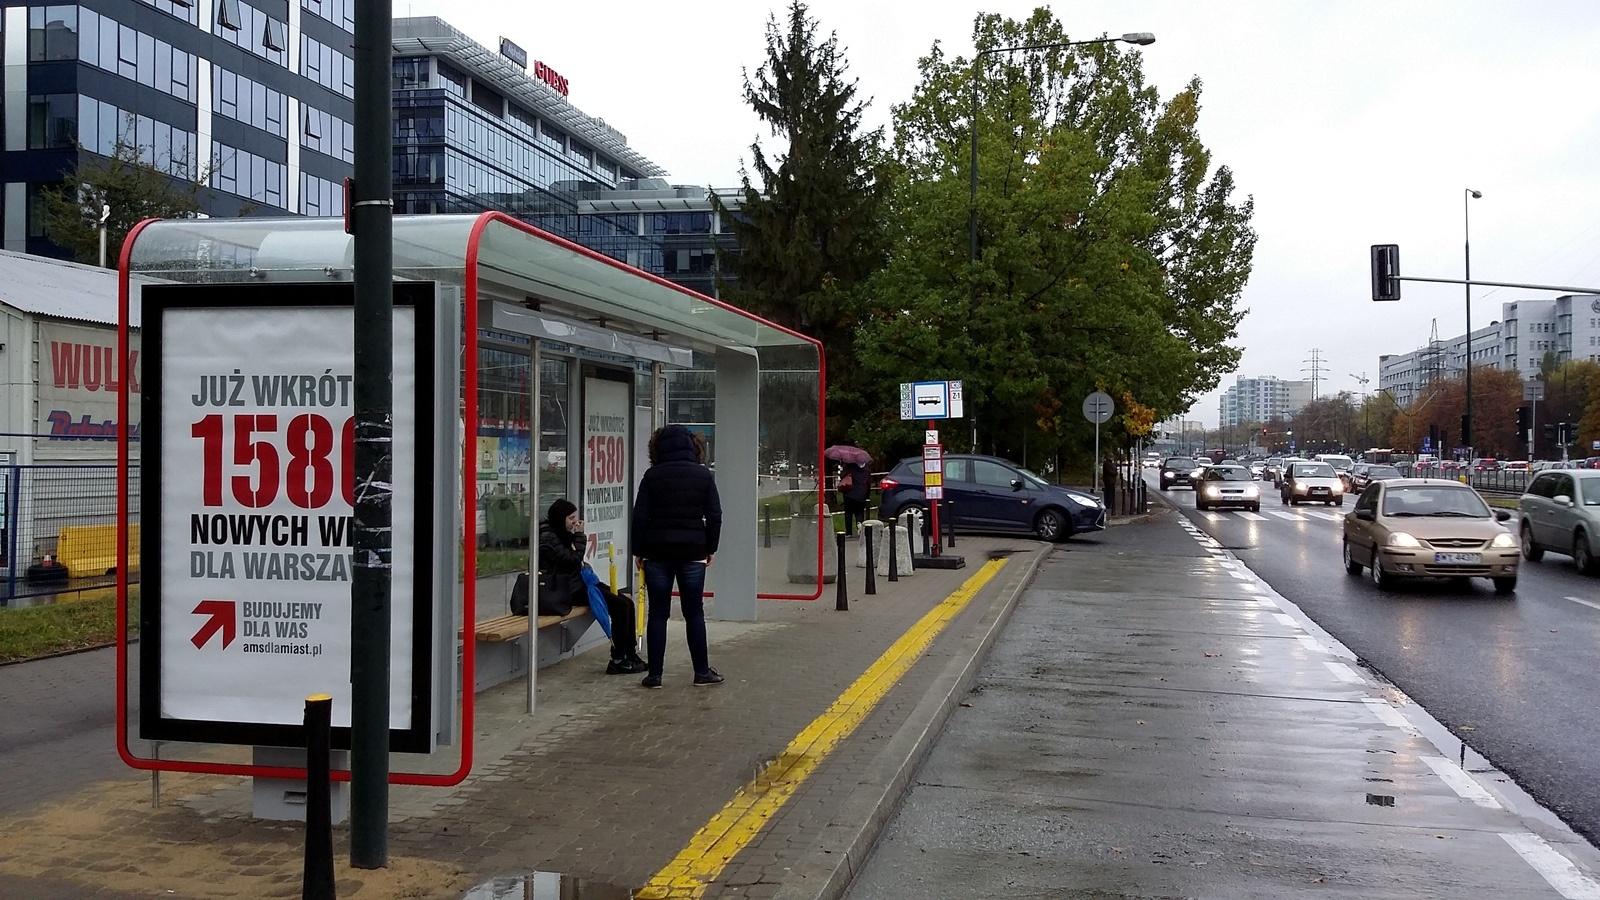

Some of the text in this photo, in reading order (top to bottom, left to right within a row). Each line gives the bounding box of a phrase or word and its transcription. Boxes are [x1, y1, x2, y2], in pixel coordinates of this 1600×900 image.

[534, 60, 569, 96] GUESS
[191, 368, 353, 407] JUŻ WKRÓT
[587, 436, 625, 485] 1580
[190, 513, 308, 546] NOWYCH
[190, 551, 236, 579] DLA
[242, 601, 323, 620] BUDUJEMY
[242, 621, 308, 639] DLA WAS
[242, 641, 323, 657] amsdlamiast.pl
